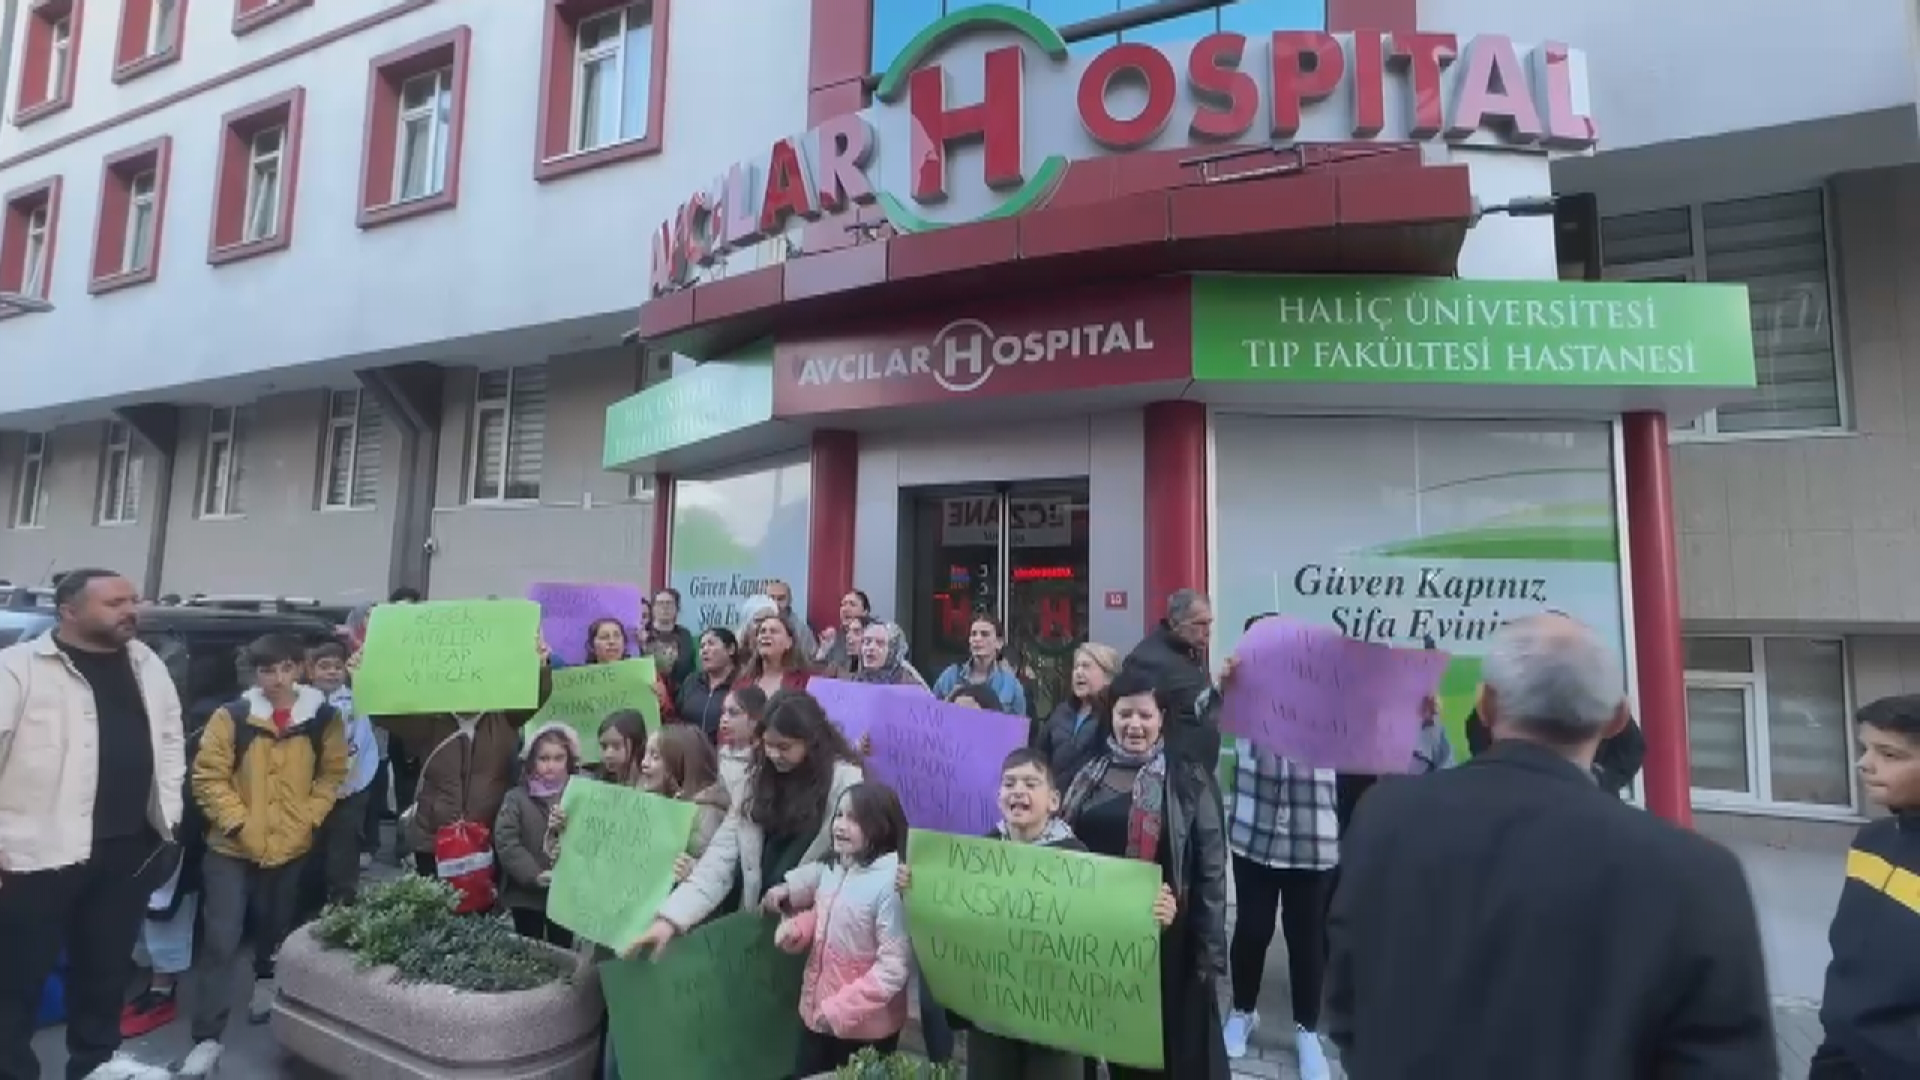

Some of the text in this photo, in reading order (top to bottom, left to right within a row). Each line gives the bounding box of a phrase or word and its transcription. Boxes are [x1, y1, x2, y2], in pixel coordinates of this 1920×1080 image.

[1279, 291, 1658, 331] HALİÇ ÜNİVERSİTESİ
[797, 318, 1155, 386] AVCILAR HOSPITAL
[1241, 335, 1698, 375] TIP FAKÜLTESİ HASTANESİ
[1293, 563, 1406, 597] Güven
